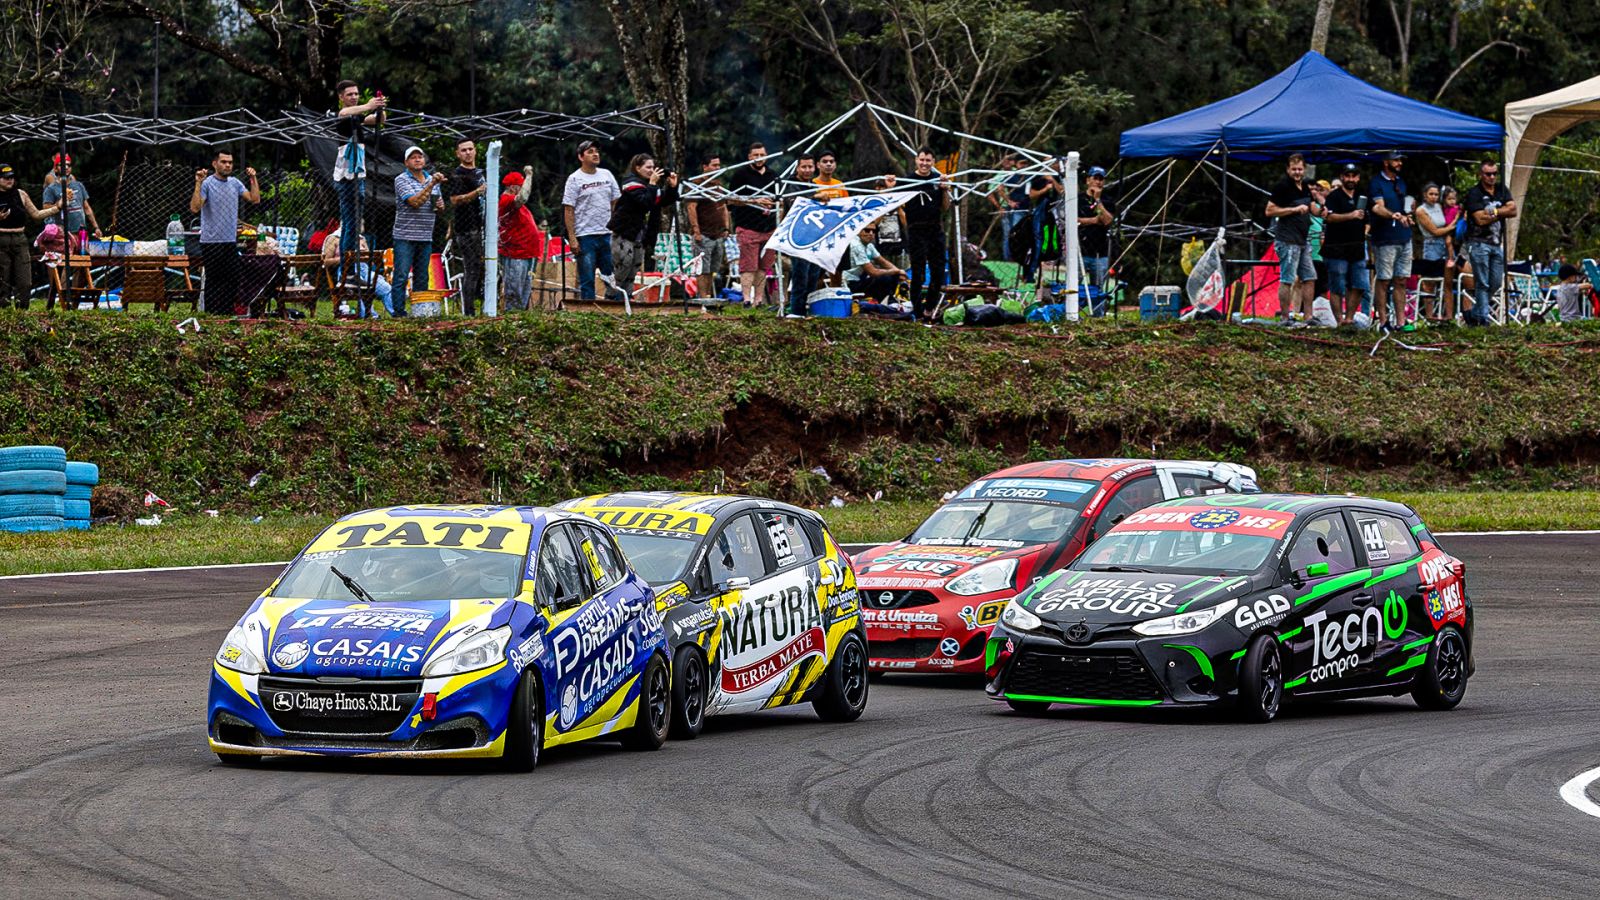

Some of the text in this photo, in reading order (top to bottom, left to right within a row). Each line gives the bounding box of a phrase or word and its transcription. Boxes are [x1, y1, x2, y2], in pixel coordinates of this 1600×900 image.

[982, 488, 1048, 498] NEORED
[582, 511, 699, 532] TURA
[1123, 512, 1287, 531] OPEN 25 HS!
[337, 521, 514, 549] TATI
[616, 528, 691, 539] MATE
[1363, 523, 1385, 550] 44
[897, 561, 956, 576] RUS
[1421, 555, 1455, 584] OPEN
[1071, 579, 1177, 593] MILLS
[1442, 581, 1462, 611] HS!
[1035, 597, 1162, 617] GROUP
[1040, 588, 1179, 608] CAPITAL
[576, 596, 610, 634] FERTILE
[717, 579, 822, 660] NATURA
[877, 610, 887, 621] &
[888, 610, 938, 623] Urquiza
[981, 603, 1004, 621] Bi
[289, 616, 433, 632] LA FUSTA
[581, 597, 630, 658] DREAMS
[313, 638, 424, 662] CASAIS
[779, 633, 814, 667] MATE
[316, 656, 410, 672] agropecuaria
[580, 626, 635, 701] CASAIS
[732, 660, 777, 689] YERBA
[1310, 653, 1359, 683] compro
[583, 664, 633, 712] agropecuaria
[295, 692, 334, 712] Chaye
